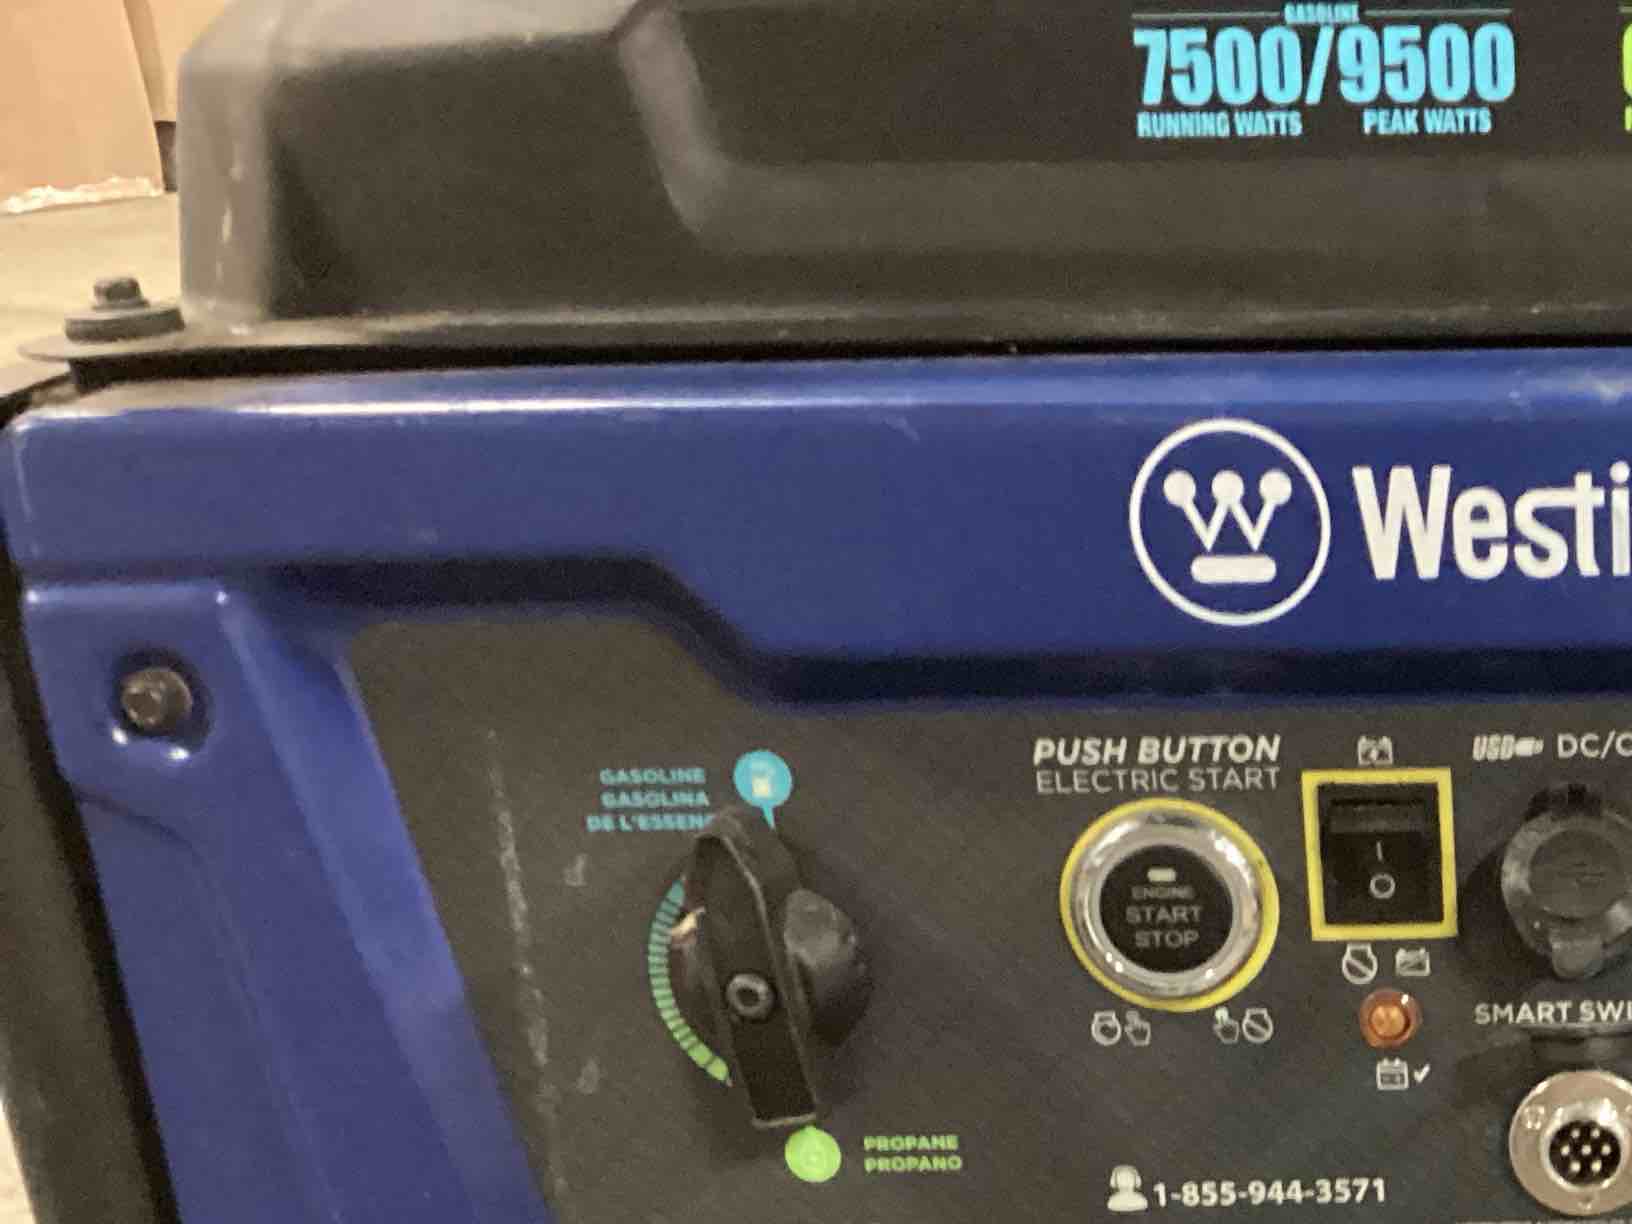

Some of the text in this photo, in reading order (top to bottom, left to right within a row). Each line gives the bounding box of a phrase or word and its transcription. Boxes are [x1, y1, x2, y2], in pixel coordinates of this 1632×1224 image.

[1133, 23, 1516, 107] 7500/9500
[1136, 110, 1303, 138] RUNNING WATTS
[1363, 107, 1492, 135] PEAK WATTS
[1033, 733, 1281, 767] PUSH BUTTON
[600, 767, 706, 785] GASOLINE
[1036, 766, 1281, 795] ELECTRIC START
[1126, 904, 1203, 924] START
[1135, 929, 1199, 949] STOP
[1474, 1000, 1572, 1025] SMART
[863, 1135, 959, 1151] PROPANE
[863, 1154, 963, 1172] PROPANO
[1153, 1176, 1386, 1208] 1-855-944-3571
